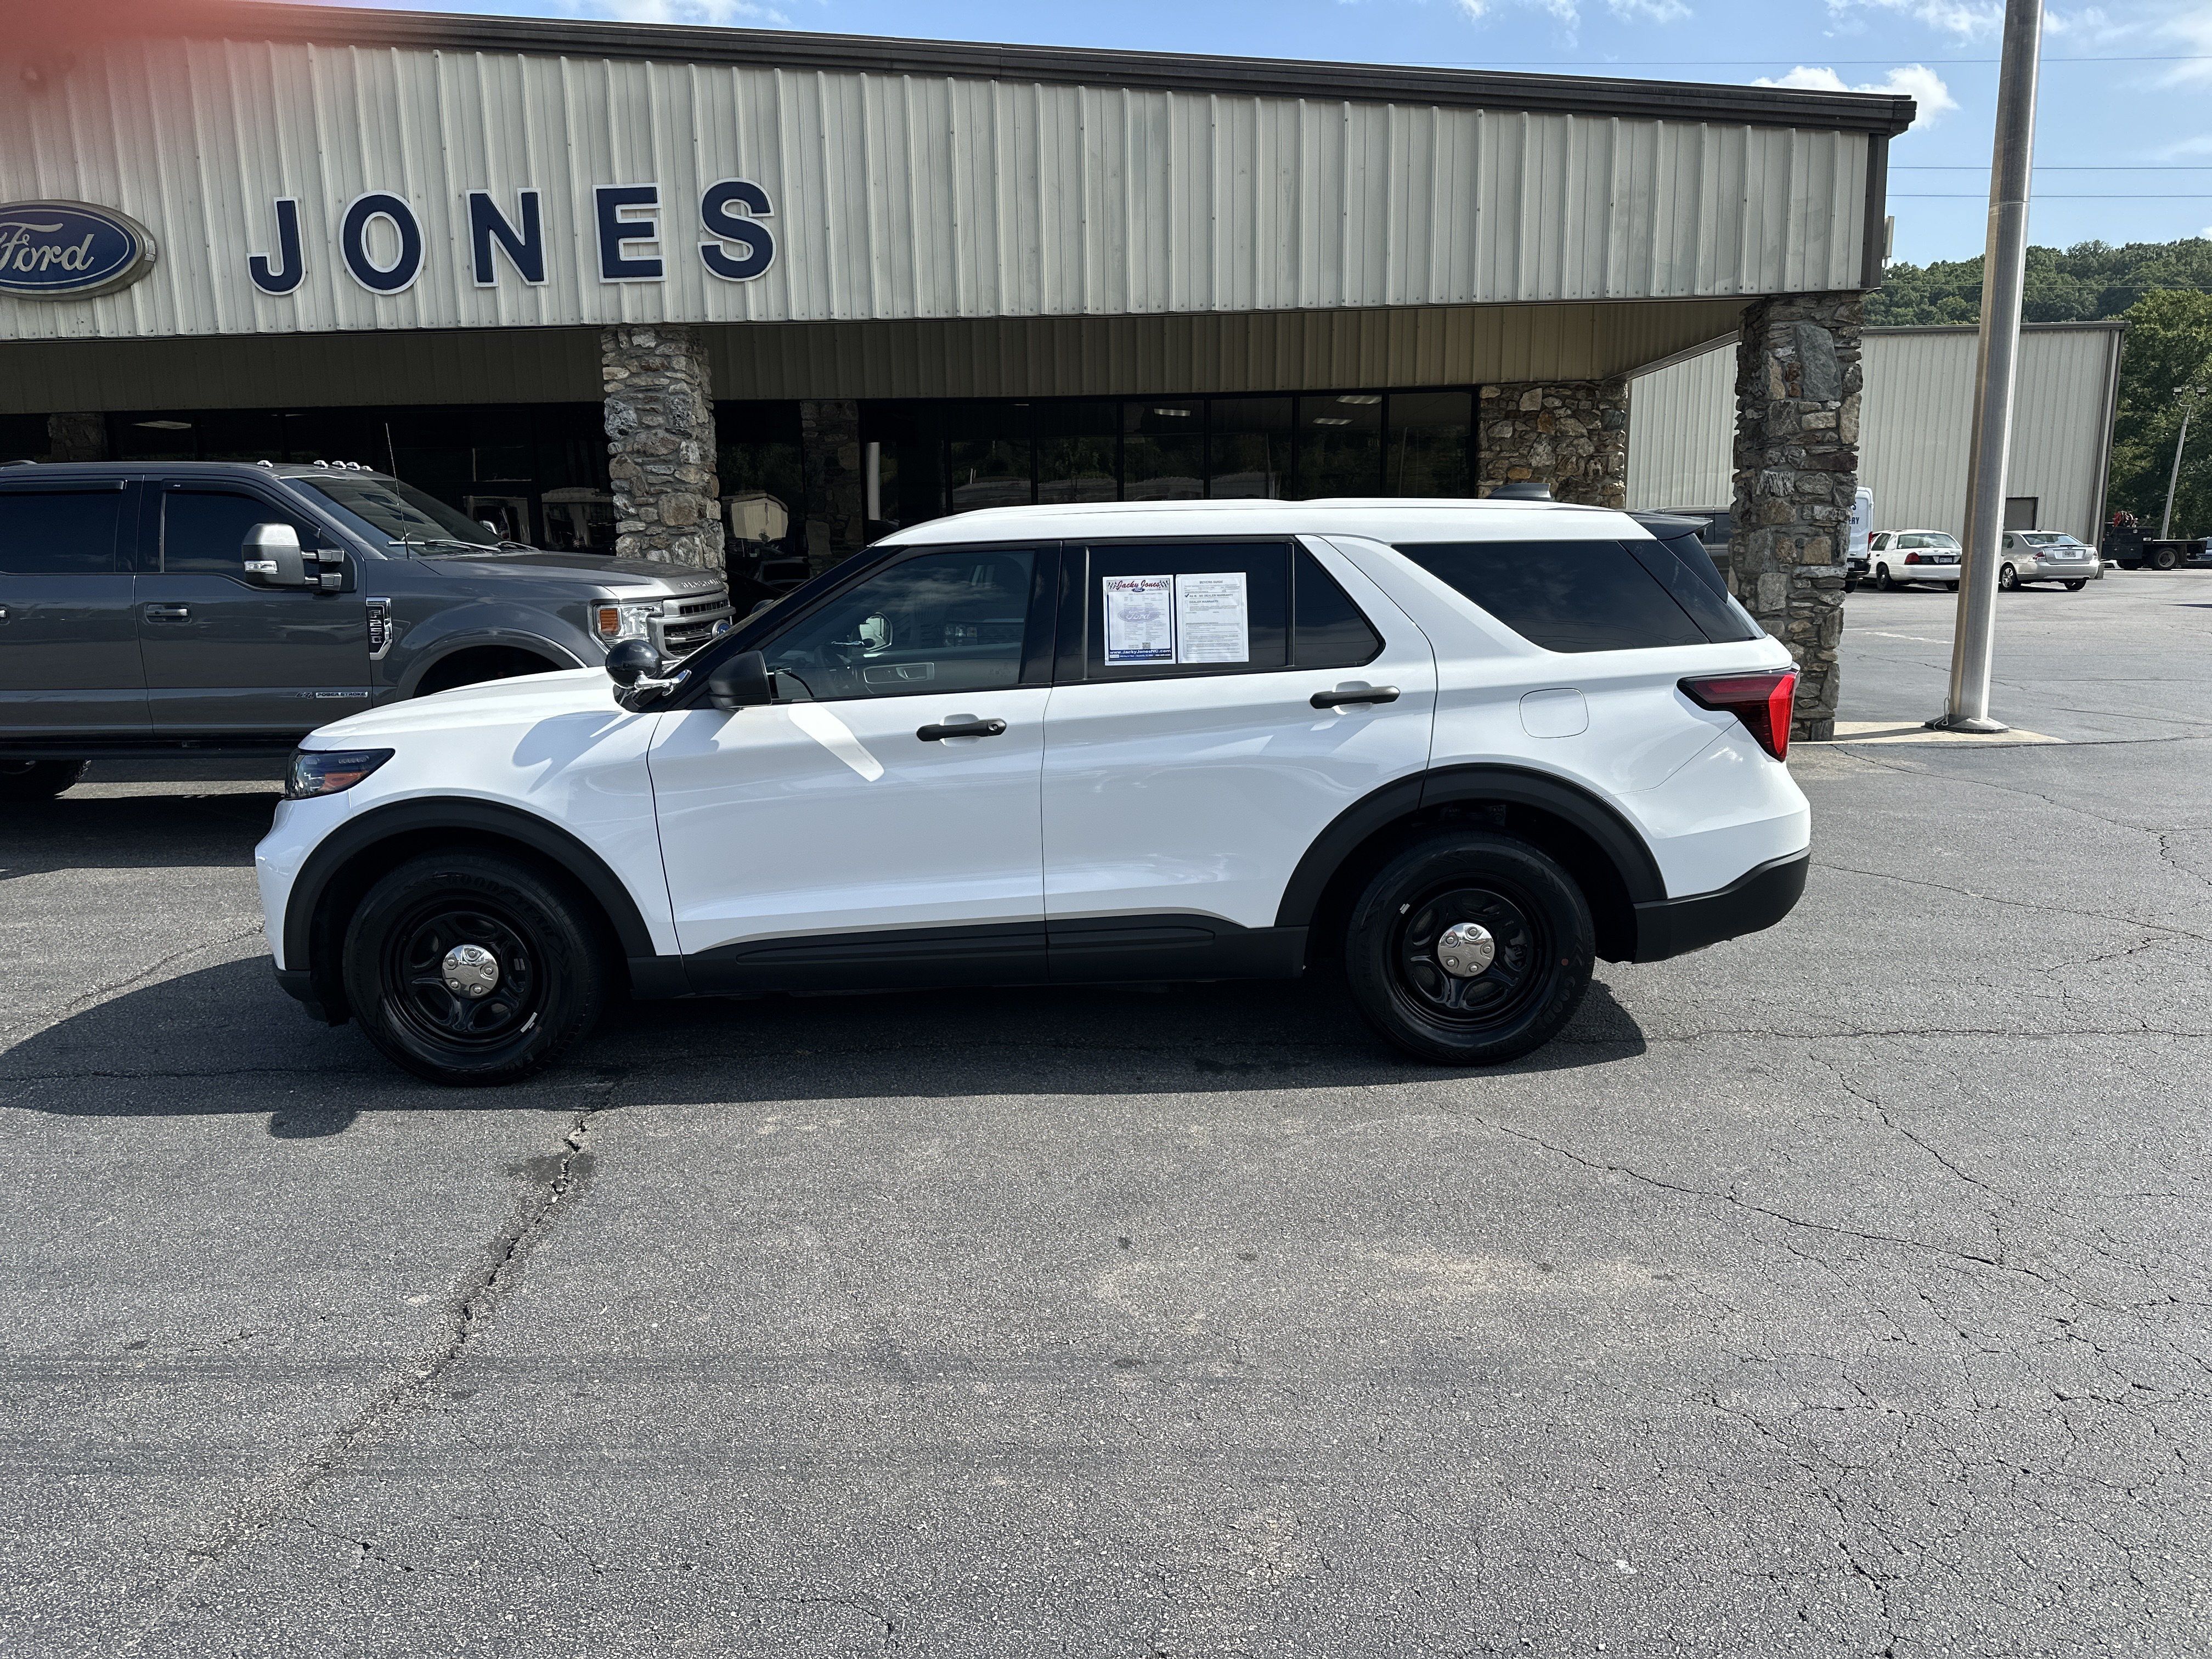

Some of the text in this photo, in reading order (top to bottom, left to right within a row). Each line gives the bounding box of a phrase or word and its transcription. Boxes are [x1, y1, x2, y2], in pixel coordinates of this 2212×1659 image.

[0, 222, 94, 272] Ford
[247, 178, 776, 295] JONES
[1116, 579, 1160, 590] Jacky Jones
